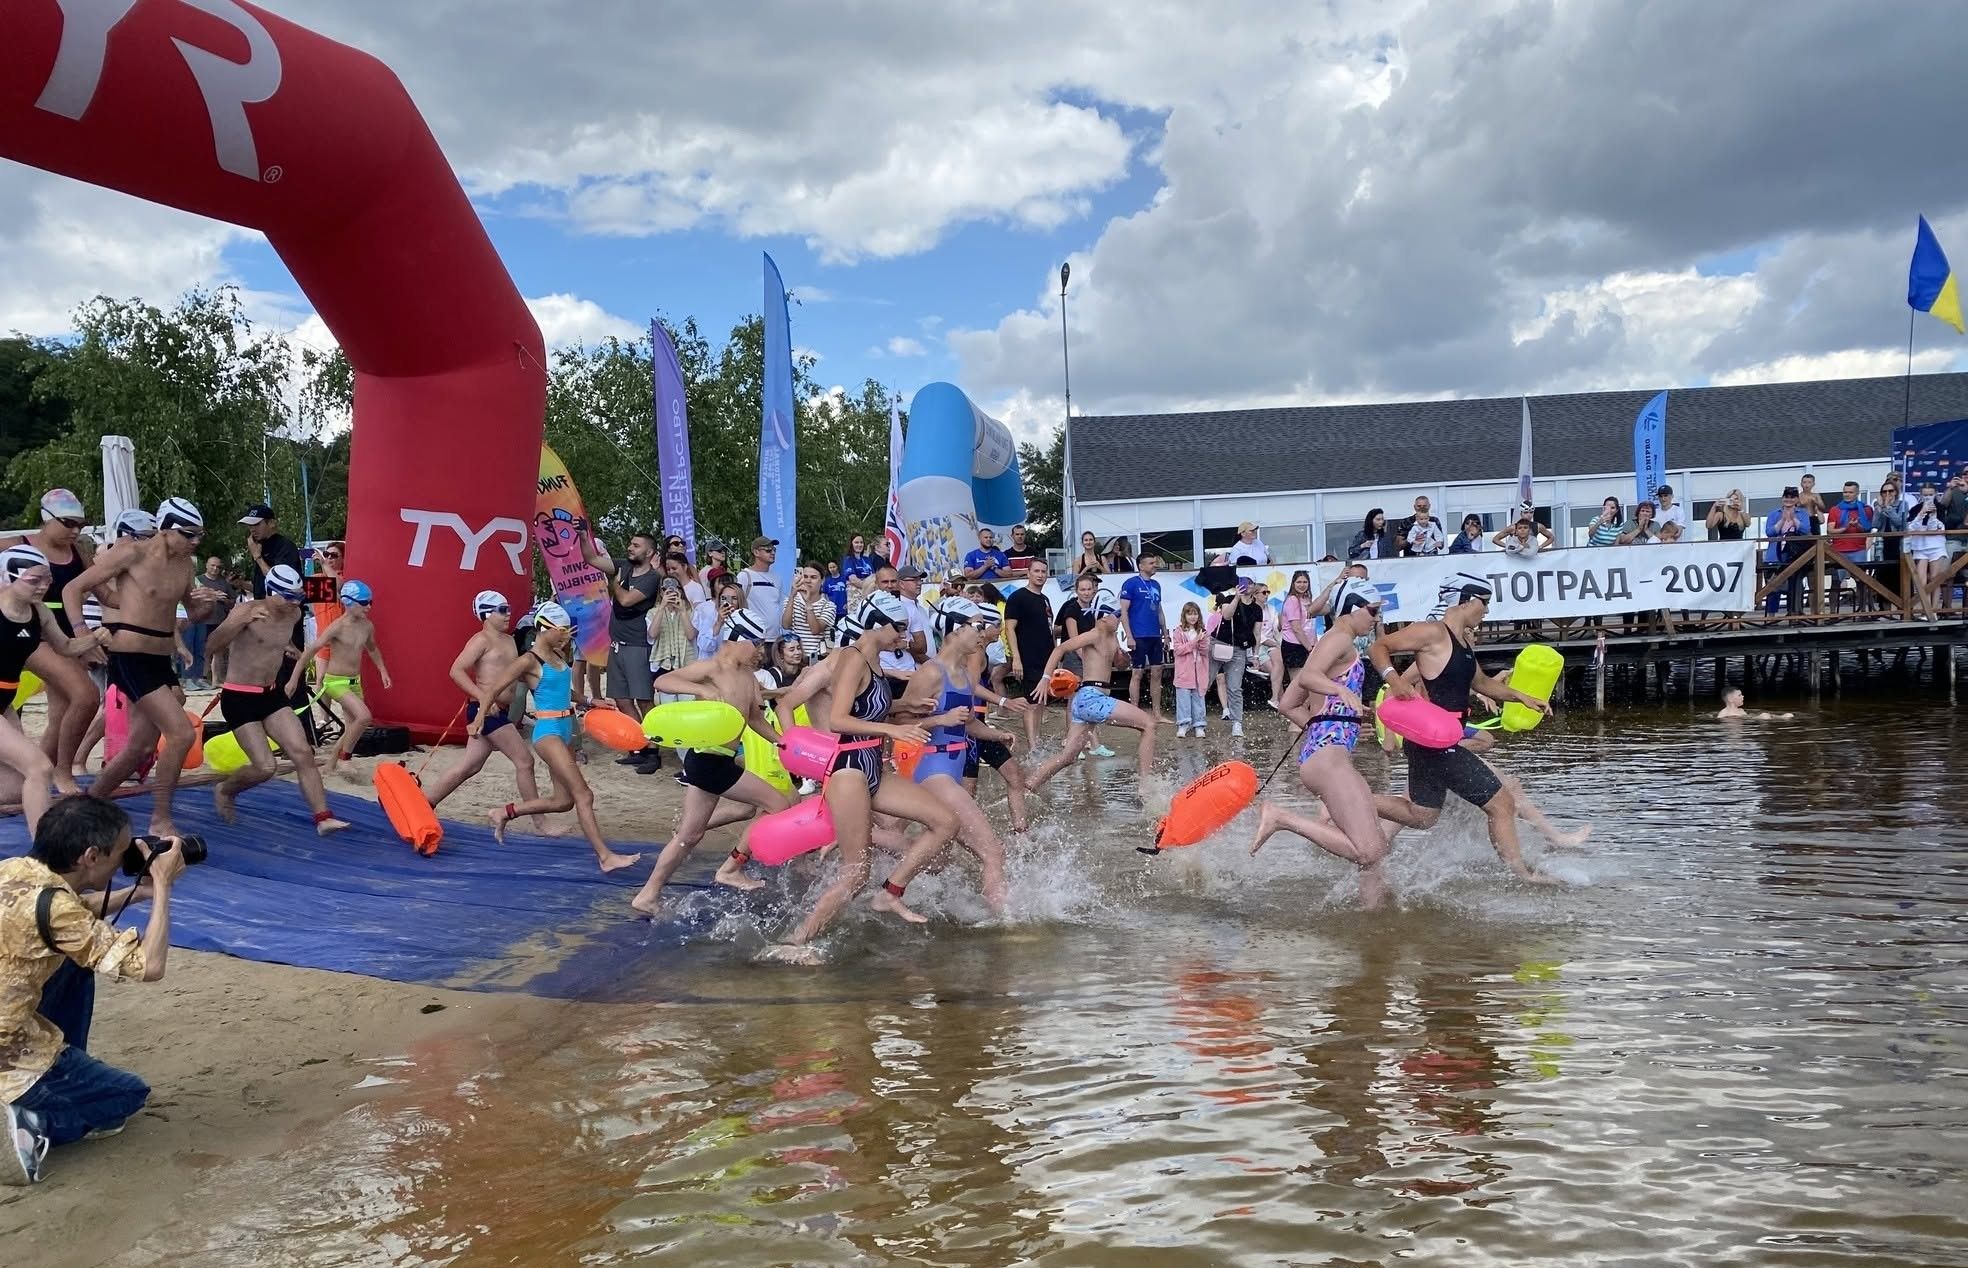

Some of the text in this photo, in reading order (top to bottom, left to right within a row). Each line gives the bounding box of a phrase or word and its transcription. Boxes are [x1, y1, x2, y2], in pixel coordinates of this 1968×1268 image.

[400, 508, 528, 575] TYR
[1486, 567, 1633, 604] ТОГРАД
[1661, 561, 1744, 594] 2007
[1185, 767, 1231, 800] SPEED
